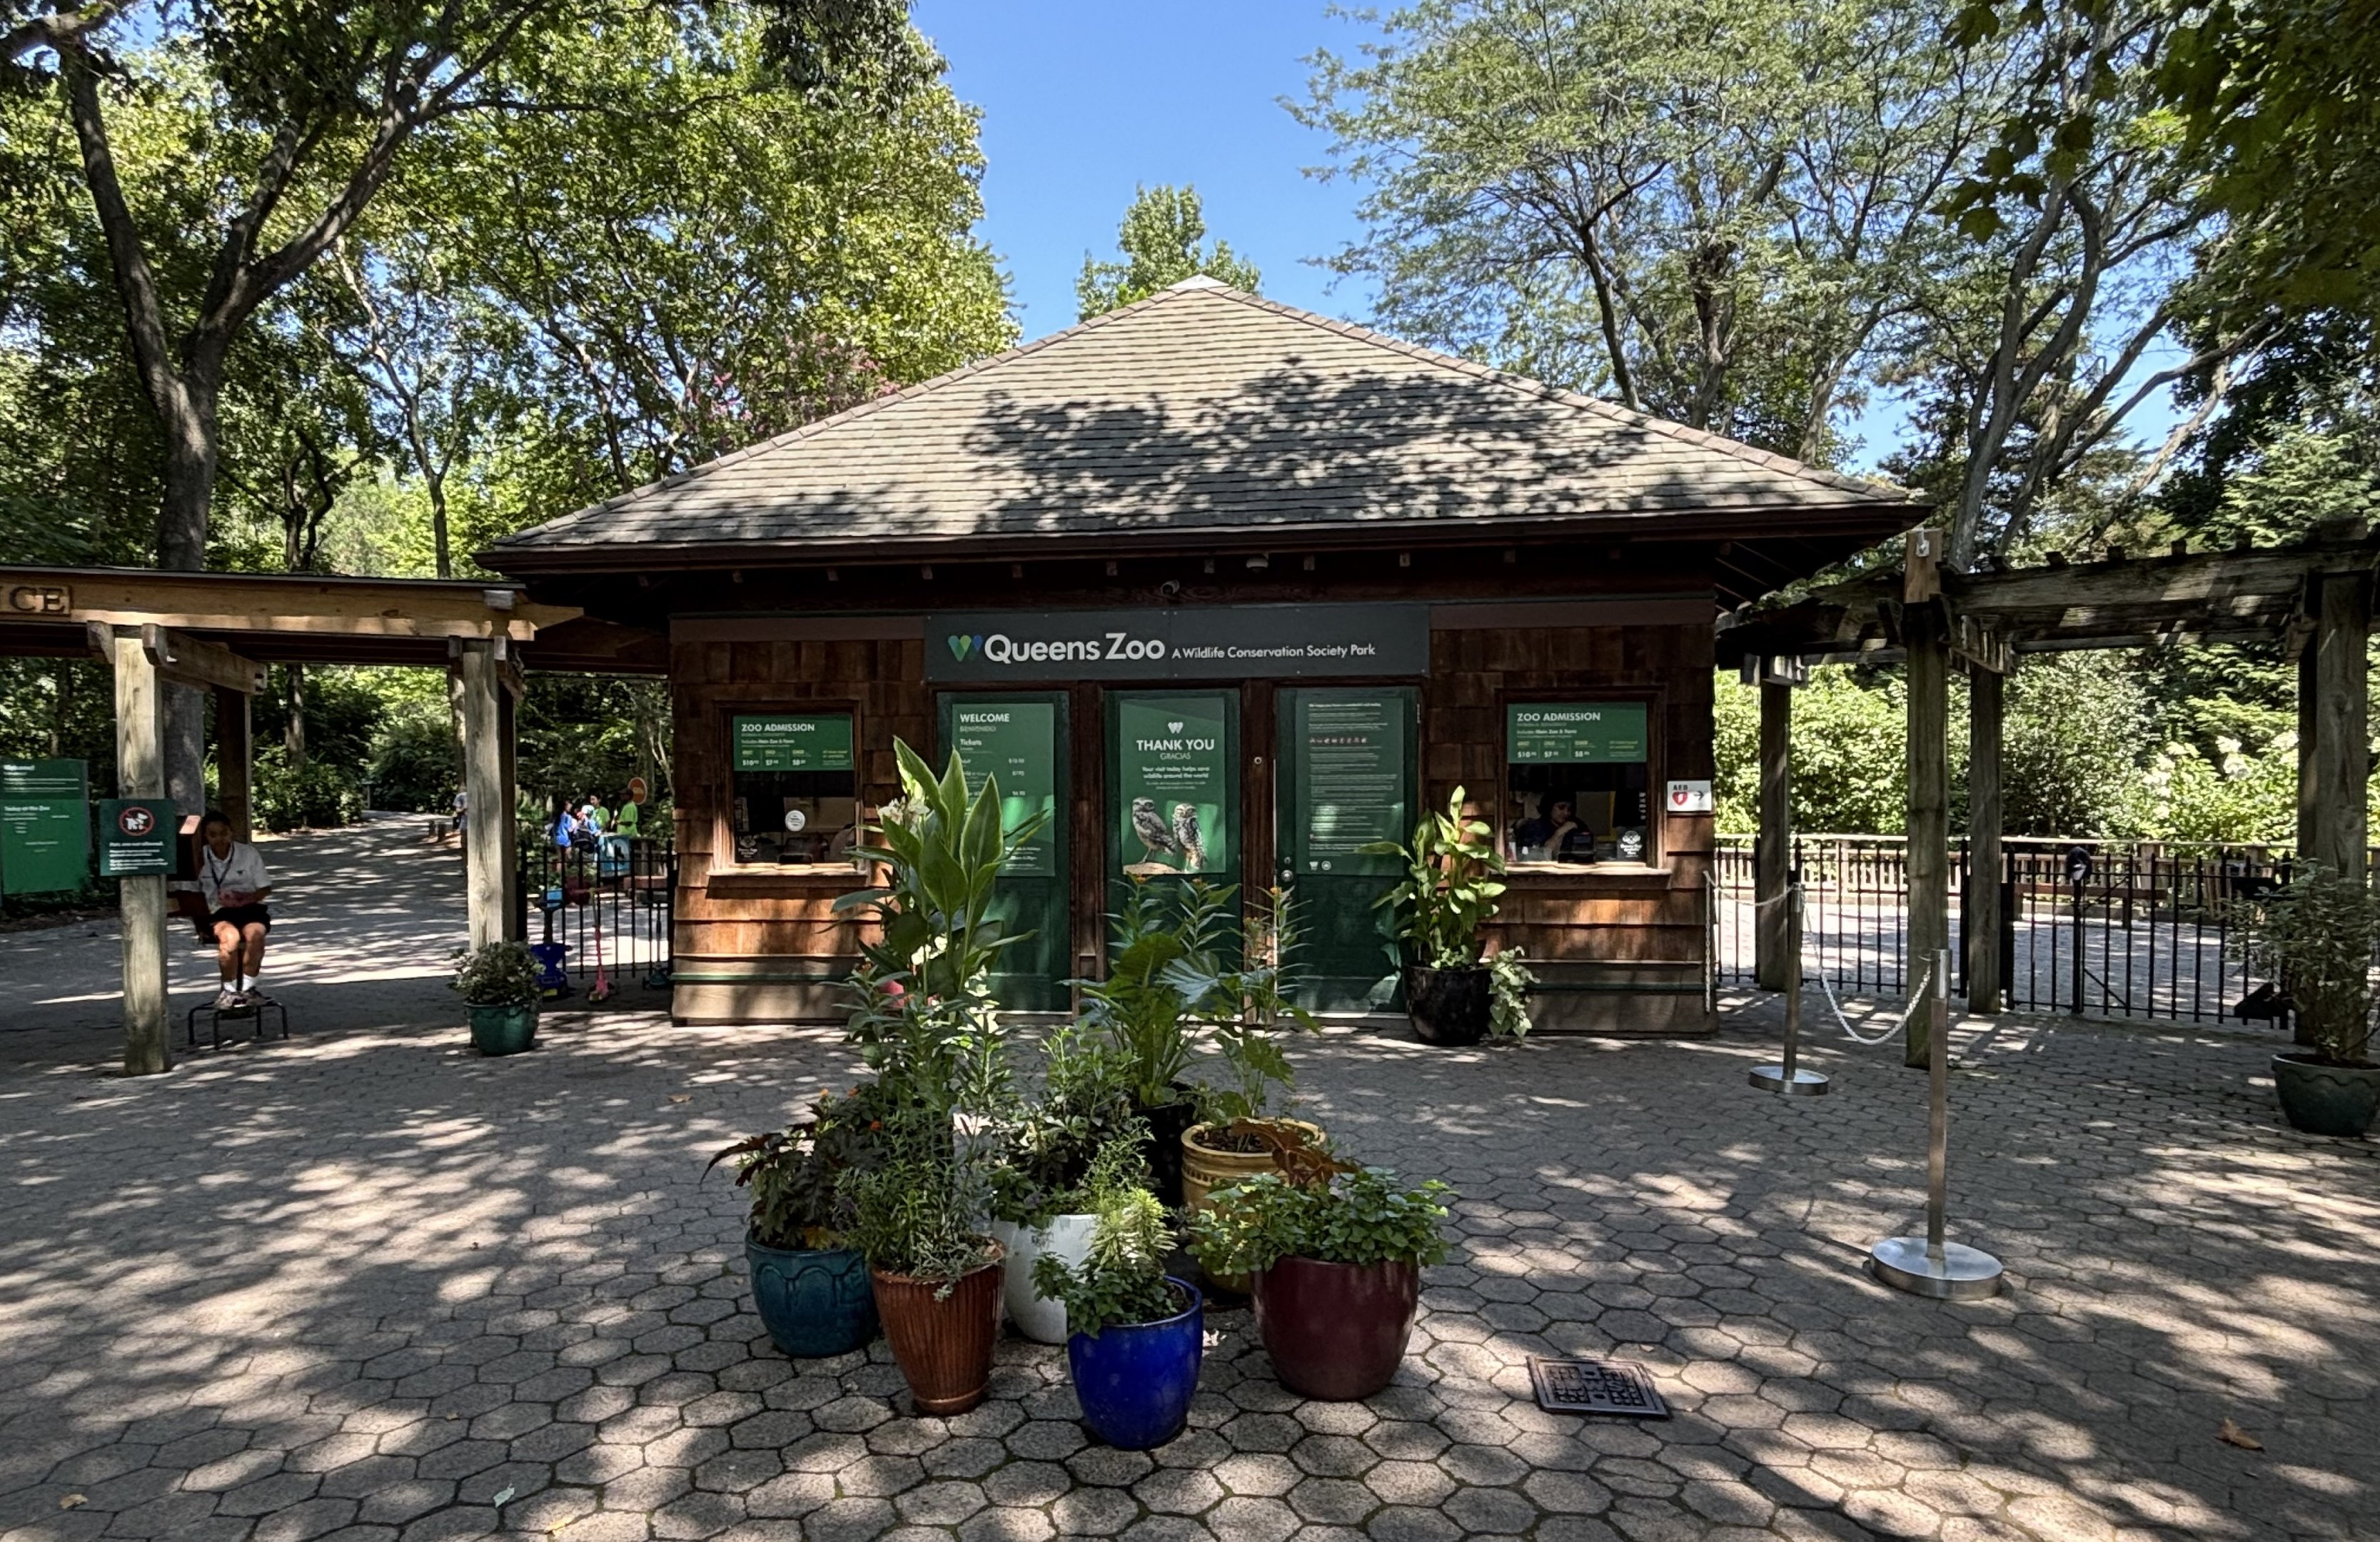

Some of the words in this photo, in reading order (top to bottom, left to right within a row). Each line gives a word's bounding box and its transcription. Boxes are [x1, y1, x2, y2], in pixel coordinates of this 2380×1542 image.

[0, 585, 65, 612] CE
[984, 634, 1100, 664] Queens
[1105, 633, 1166, 660] Zoo
[1171, 648, 1182, 660] A
[1182, 646, 1224, 658] Wildlife
[1227, 645, 1304, 657] Conservation
[1306, 644, 1348, 658] Society
[1351, 643, 1376, 656] Park
[959, 713, 1010, 722] WELCOME
[1517, 713, 1541, 722] ZOO
[1543, 712, 1601, 721] ADMISSION
[741, 723, 762, 732] ZOO
[764, 723, 815, 732] ADMISSION
[1136, 740, 1182, 751] THANK
[1185, 739, 1215, 750] YOU
[1159, 752, 1191, 760] GRACIAS
